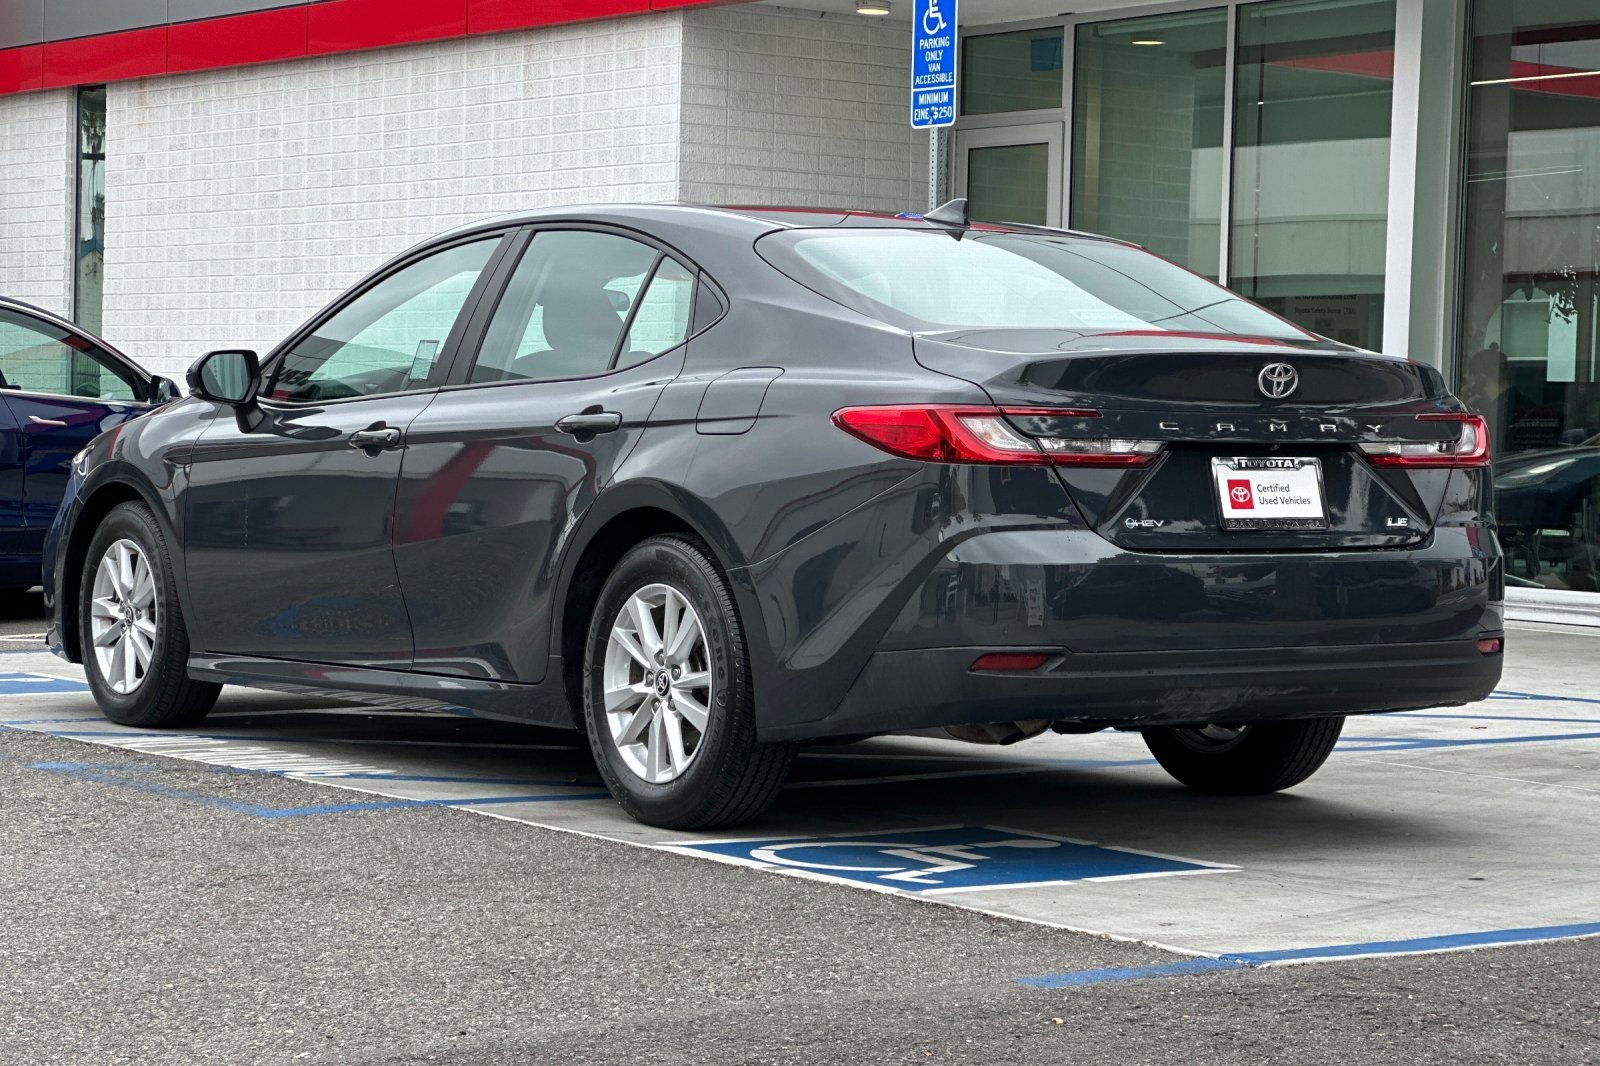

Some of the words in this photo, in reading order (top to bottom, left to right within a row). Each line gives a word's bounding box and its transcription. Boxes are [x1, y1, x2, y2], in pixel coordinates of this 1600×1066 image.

[920, 36, 950, 50] PARKING
[925, 50, 944, 62] ONLY
[928, 63, 941, 72] VAN
[915, 72, 953, 85] ACCESSIBLE
[918, 91, 949, 105] MINIMUM
[932, 106, 953, 120] $250
[1159, 421, 1384, 433] CAMRY
[1240, 459, 1294, 468] TOYOTA
[1256, 484, 1290, 493] Certified
[1259, 496, 1279, 505] Used
[1280, 496, 1311, 505] Vehicles
[1387, 517, 1408, 526] LE
